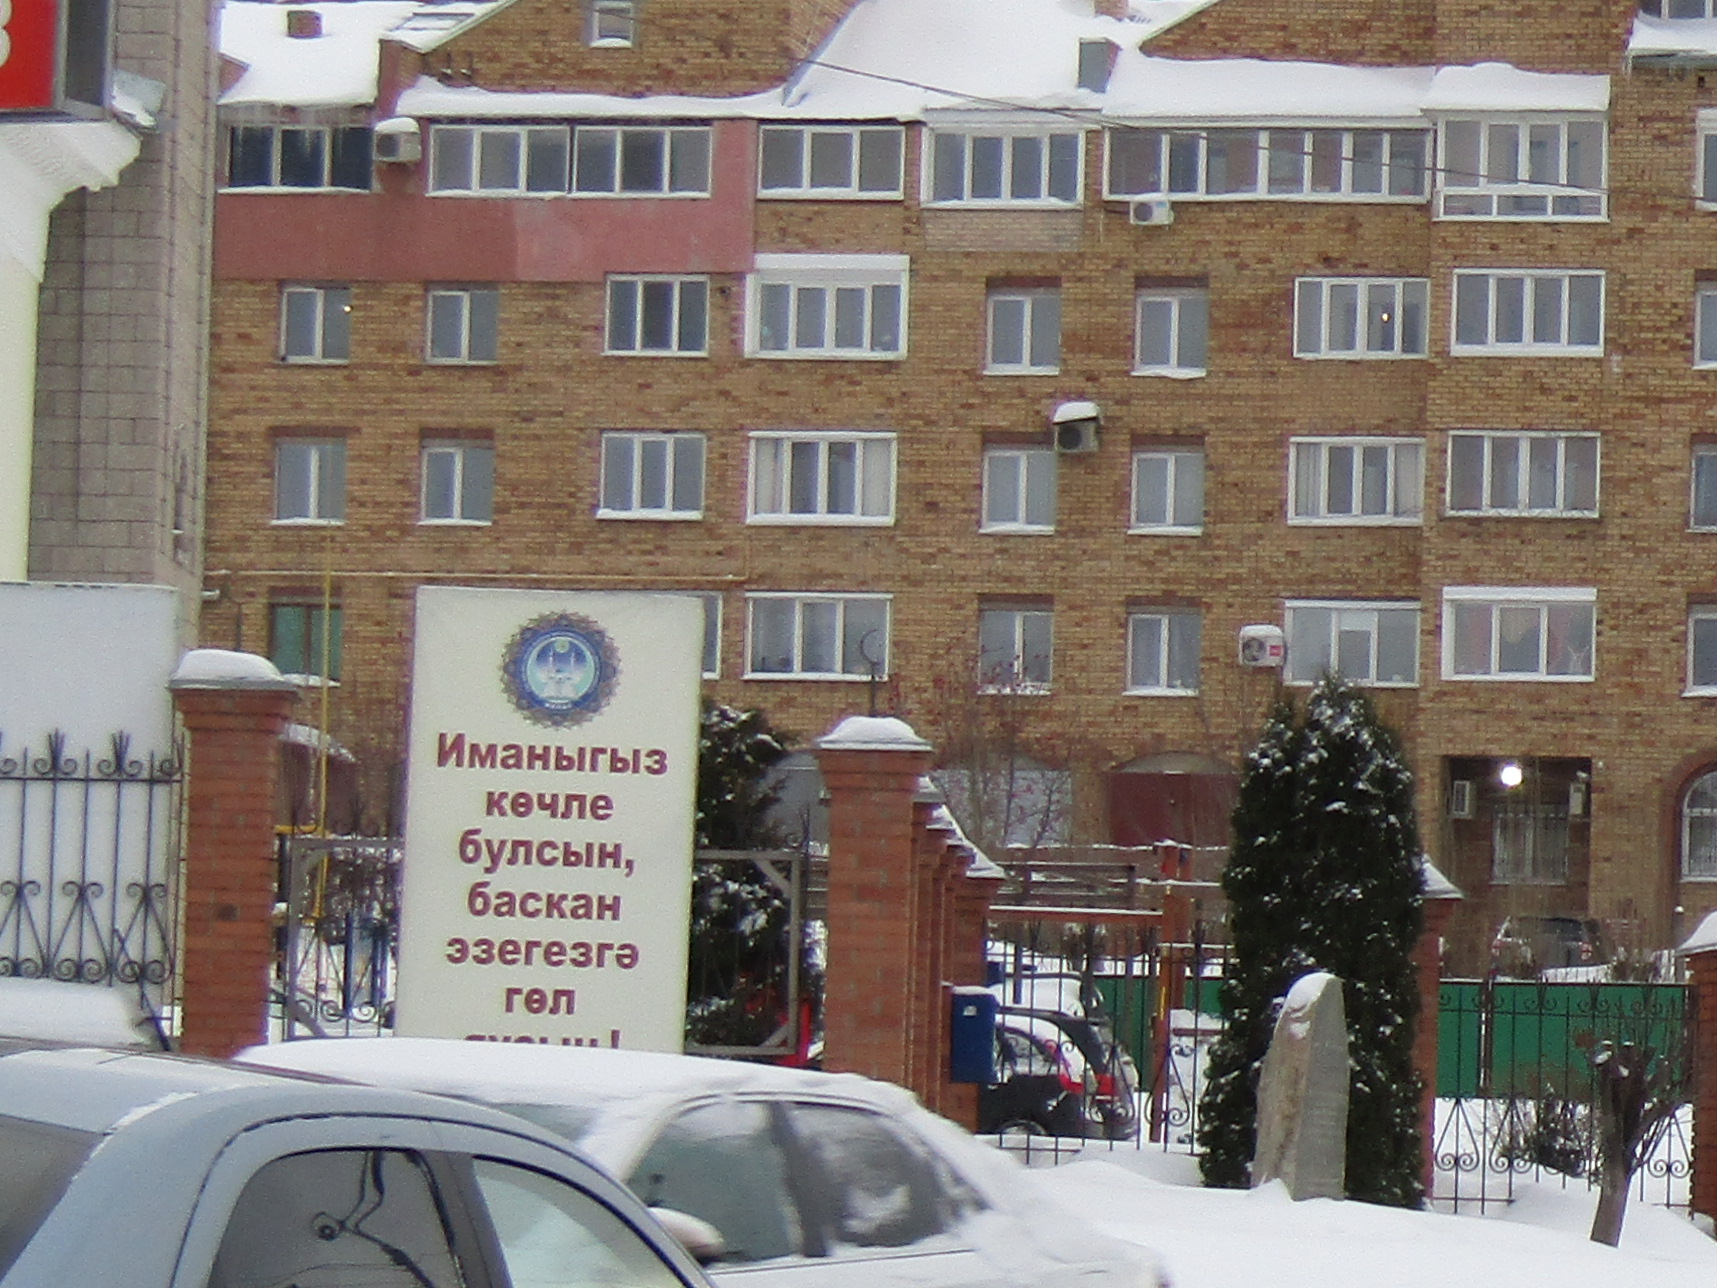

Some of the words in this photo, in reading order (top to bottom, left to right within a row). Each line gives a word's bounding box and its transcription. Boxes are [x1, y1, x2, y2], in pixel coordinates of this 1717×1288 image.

[438, 733, 668, 776] Иманыгыз
[485, 790, 614, 821] көчле
[460, 829, 635, 877] булсын,
[467, 882, 622, 921] баскан
[446, 937, 639, 969] эзегезгә
[505, 986, 575, 1015] гөл
